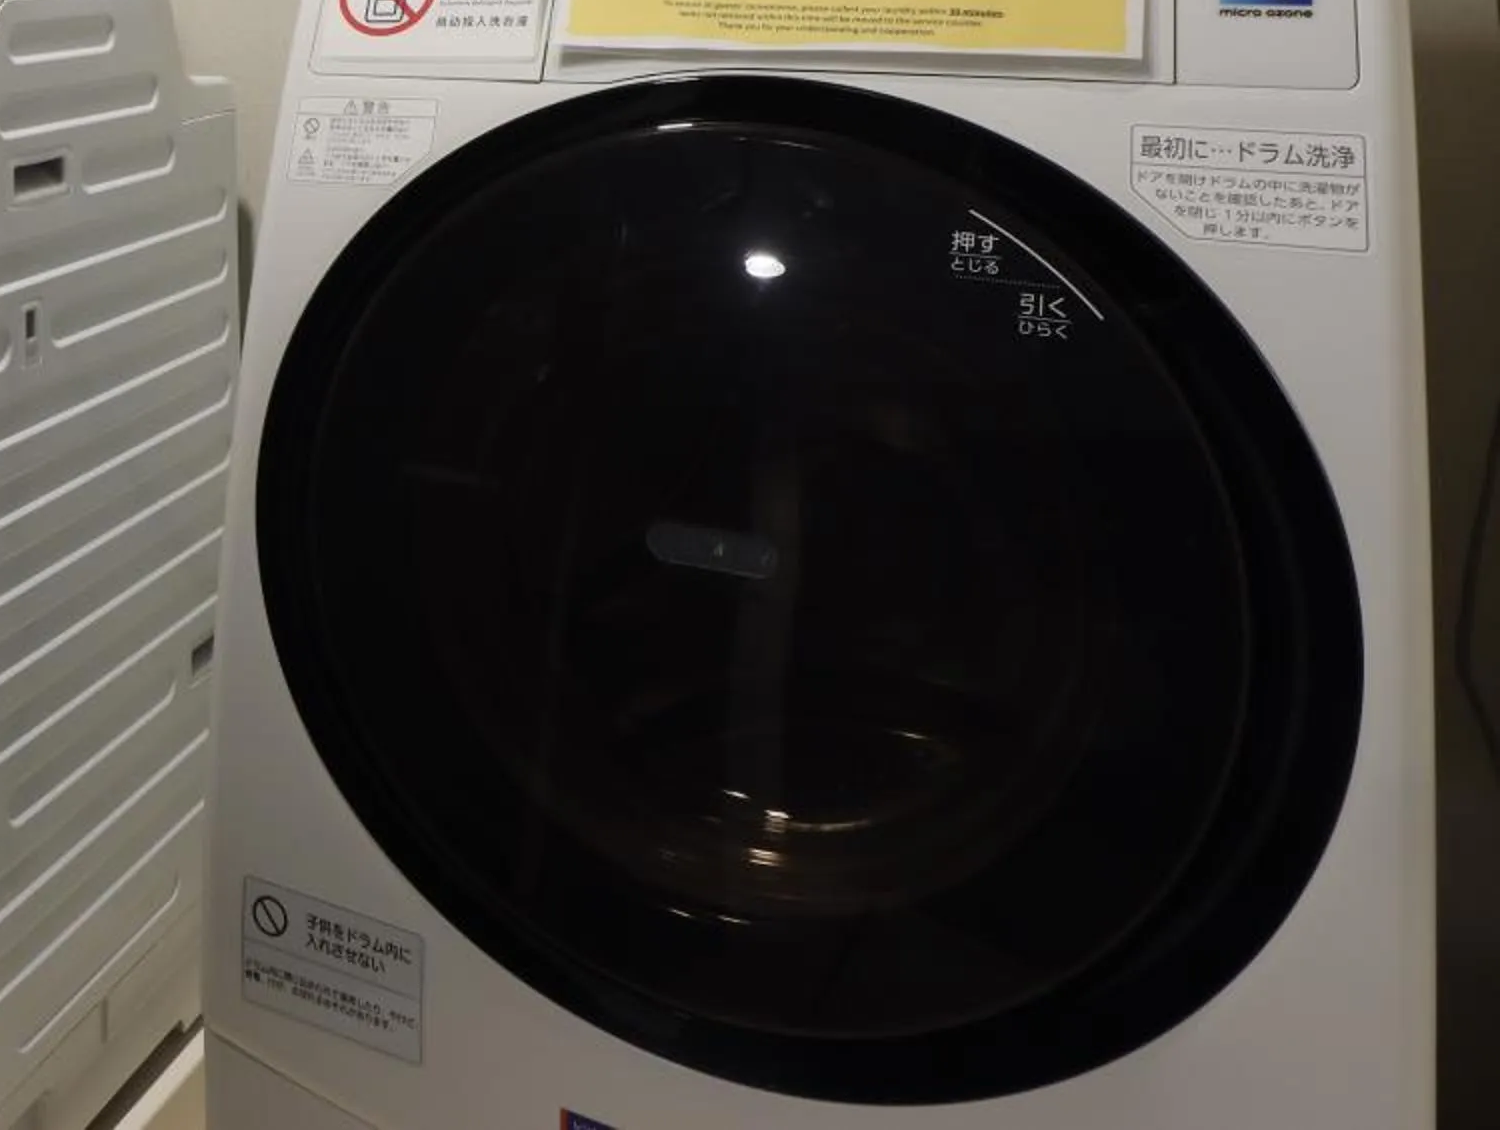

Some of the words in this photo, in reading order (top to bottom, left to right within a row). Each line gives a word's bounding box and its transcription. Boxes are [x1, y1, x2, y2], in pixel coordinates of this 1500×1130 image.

[1219, 7, 1262, 18] micro
[950, 229, 1000, 254] 押す
[950, 256, 1000, 275] とじる
[1019, 293, 1067, 318] 引く
[1018, 321, 1068, 340] ひらく
[306, 933, 387, 974] 入れさせない
